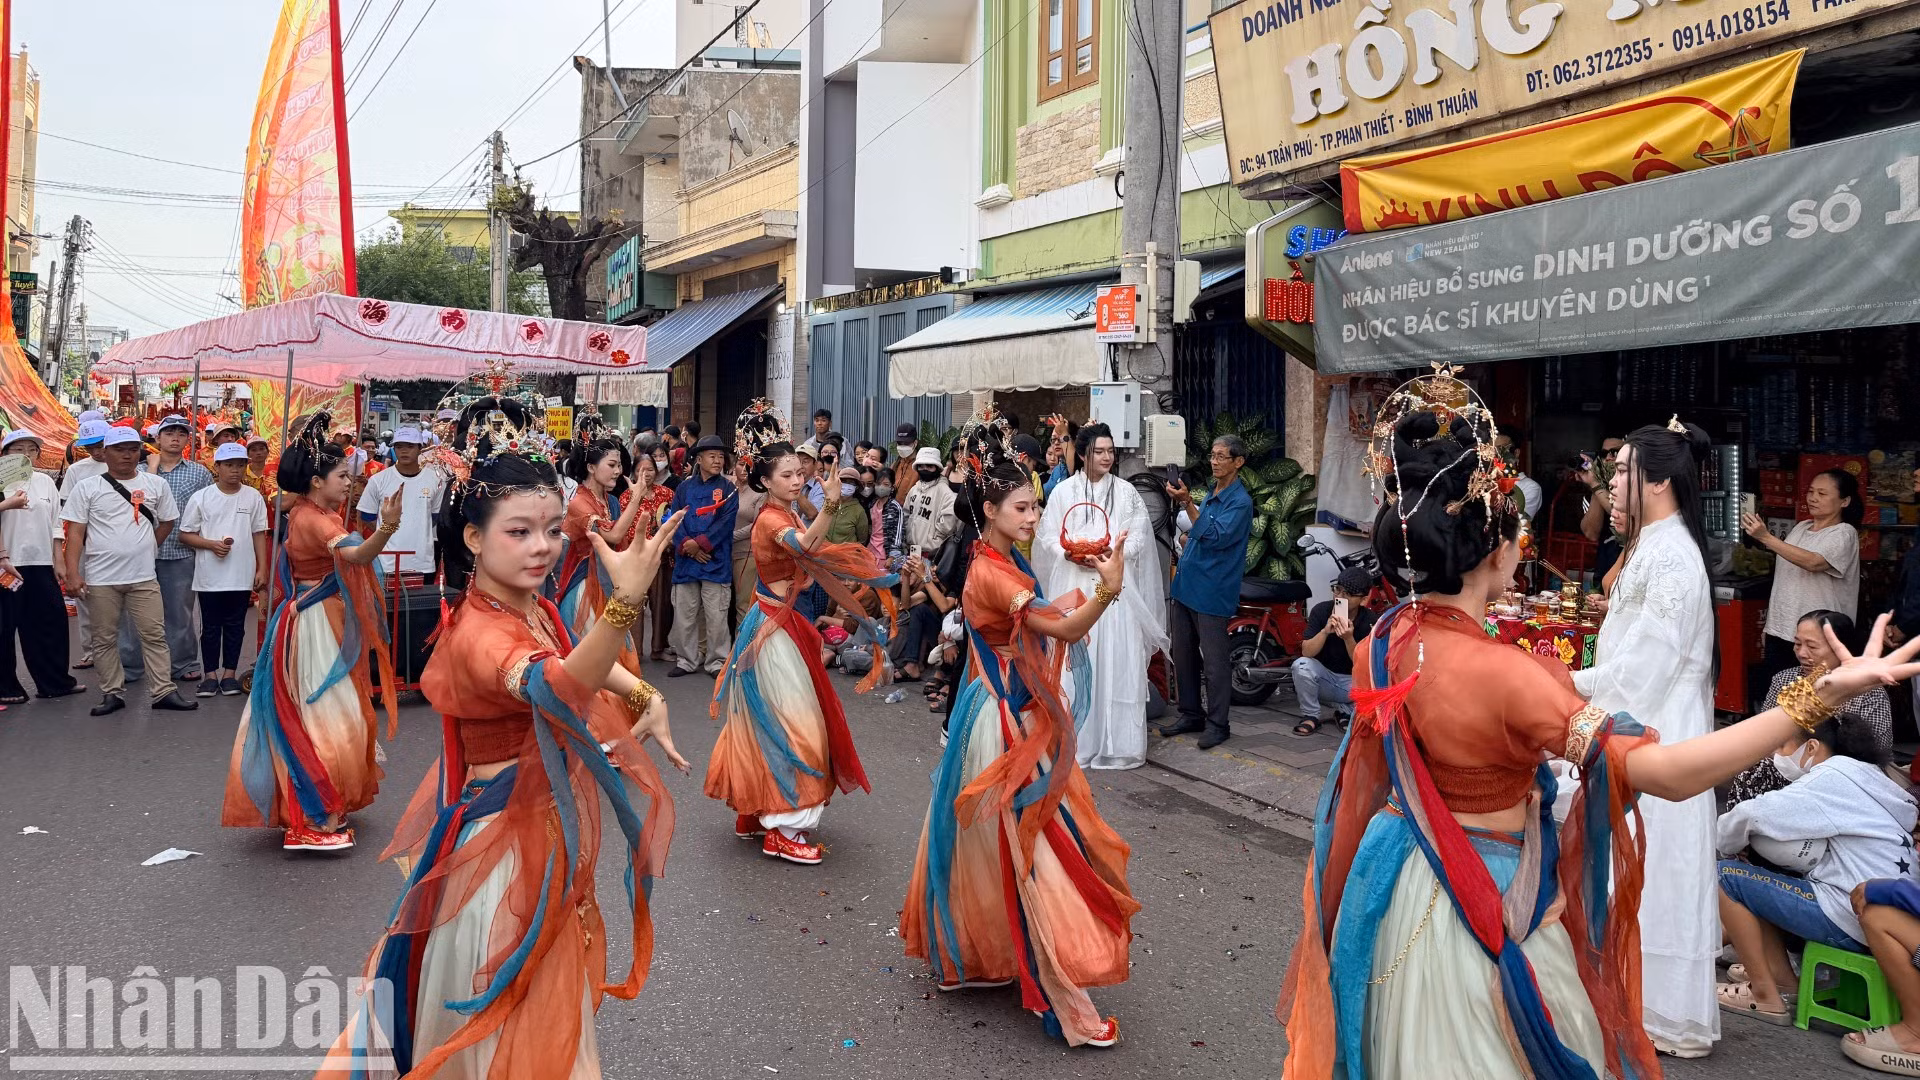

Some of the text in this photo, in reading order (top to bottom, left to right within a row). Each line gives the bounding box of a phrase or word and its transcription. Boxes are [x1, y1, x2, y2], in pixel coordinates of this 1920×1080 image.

[1242, 0, 1303, 42] DOANH
[1526, 70, 1550, 93] ĐT:
[1553, 37, 1653, 86] 062.3722355
[1672, 1, 1790, 52] 0914.018154
[1284, 0, 1568, 125] HỒNG
[1240, 158, 1255, 174] ĐC:
[1255, 153, 1266, 170] 94
[1267, 140, 1292, 167] TRẦN
[1293, 134, 1313, 159] PHÚ
[1320, 124, 1363, 152] TP.PHAN
[1363, 109, 1395, 140] THIẾT
[1405, 97, 1434, 128] BÌNH
[1437, 88, 1479, 118] THUẬN
[1340, 250, 1392, 274] Anlene
[1342, 284, 1386, 309] NHÃN
[1390, 278, 1431, 304] HIỆU
[1436, 266, 1463, 296] BỔ
[1467, 264, 1524, 291] SUNG
[1533, 241, 1615, 281] DINH
[1626, 214, 1773, 266] DƯỠNG
[1785, 178, 1862, 240] SỐ
[1424, 242, 1480, 258] NEW ZEALAND
[1342, 317, 1397, 345] ĐƯỢC
[1404, 307, 1450, 335] BÁC
[1457, 301, 1477, 330] SĨ
[1486, 288, 1597, 327] KHUYÊN
[1607, 276, 1699, 312] DÙNG
[1722, 866, 1749, 877] LONG
[1751, 872, 1771, 883] DAY
